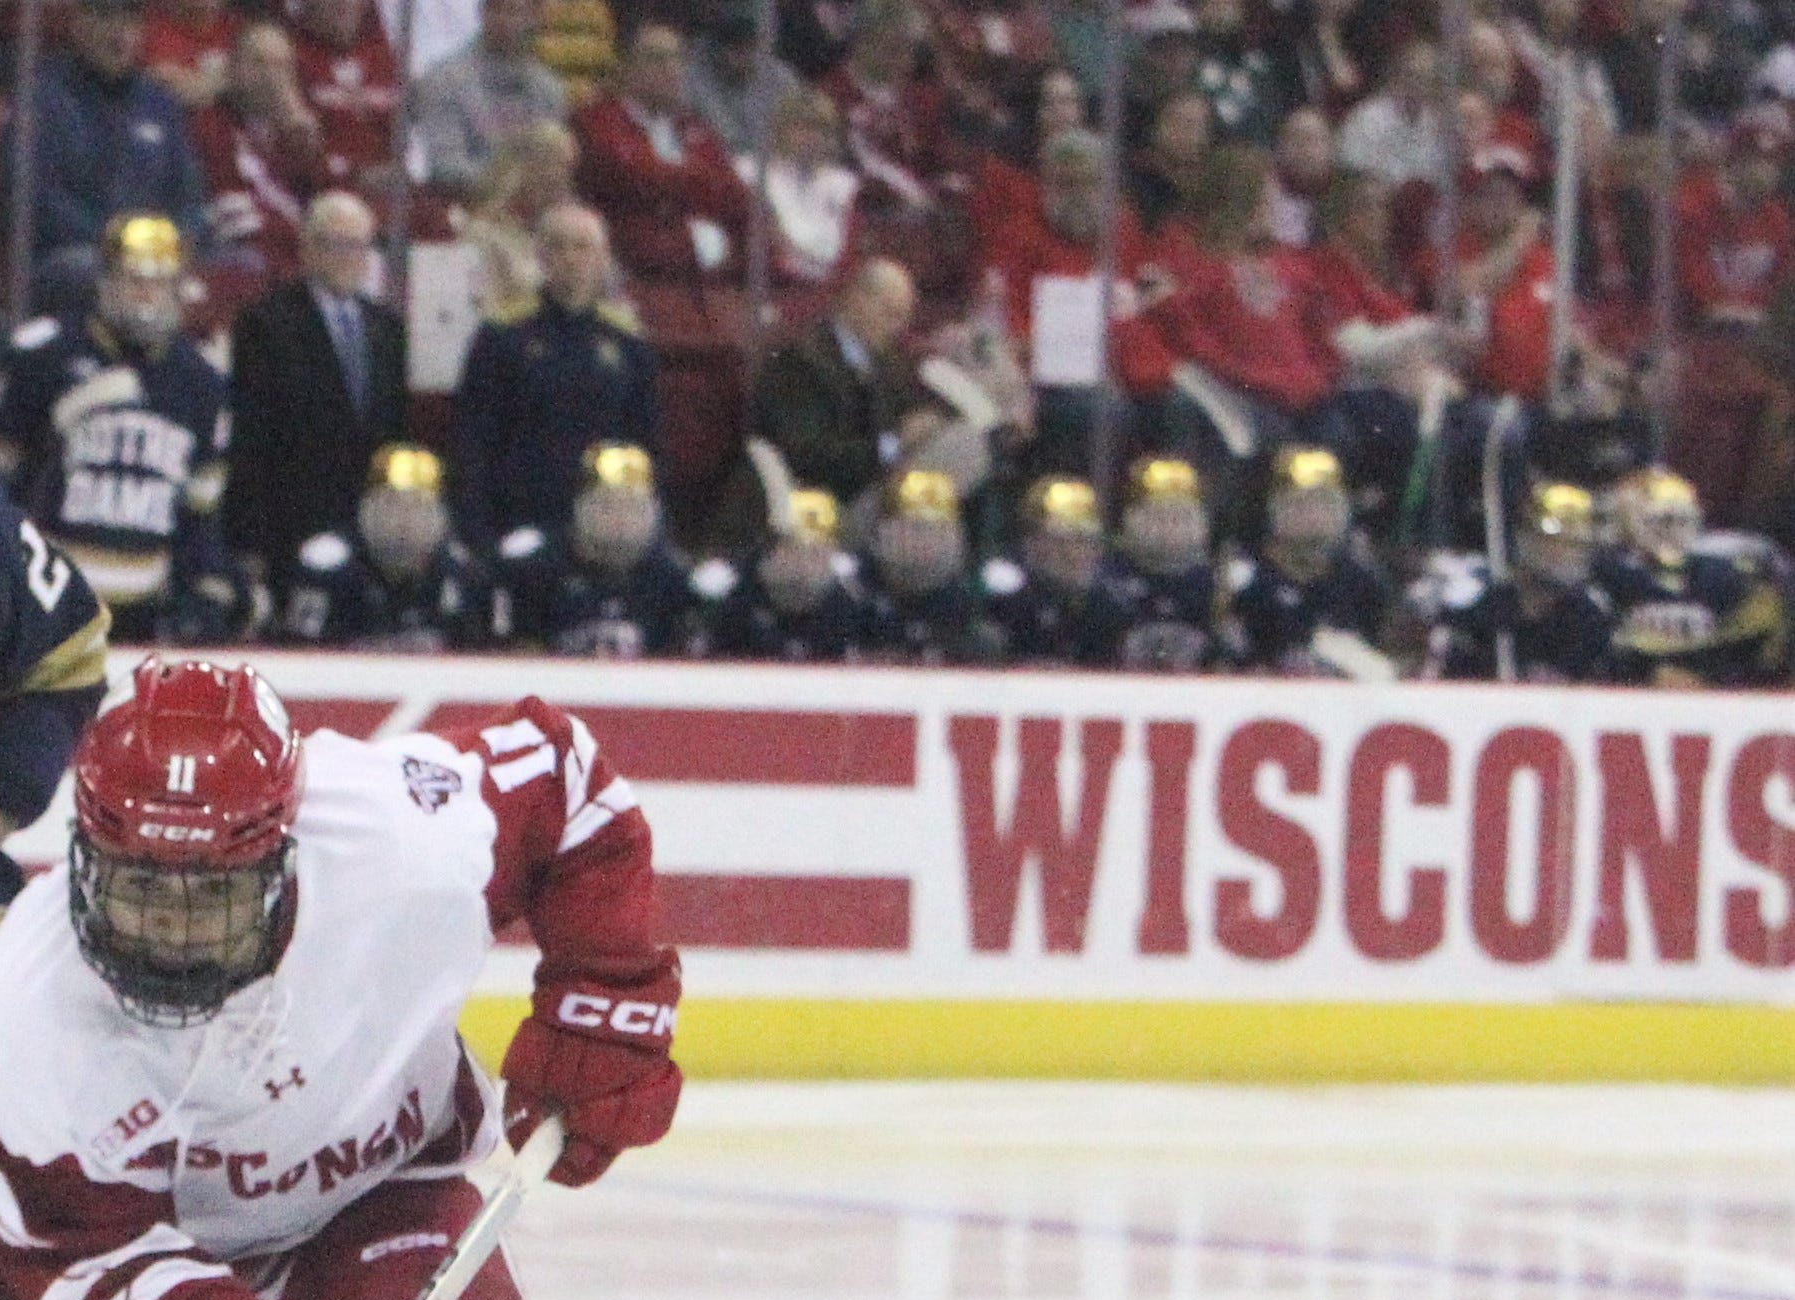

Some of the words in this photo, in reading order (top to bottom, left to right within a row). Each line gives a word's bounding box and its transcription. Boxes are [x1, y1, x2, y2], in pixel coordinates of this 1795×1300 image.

[167, 754, 196, 793] 11
[479, 717, 556, 794] 11
[138, 822, 216, 842] CCM
[947, 713, 1795, 967] WISCONS
